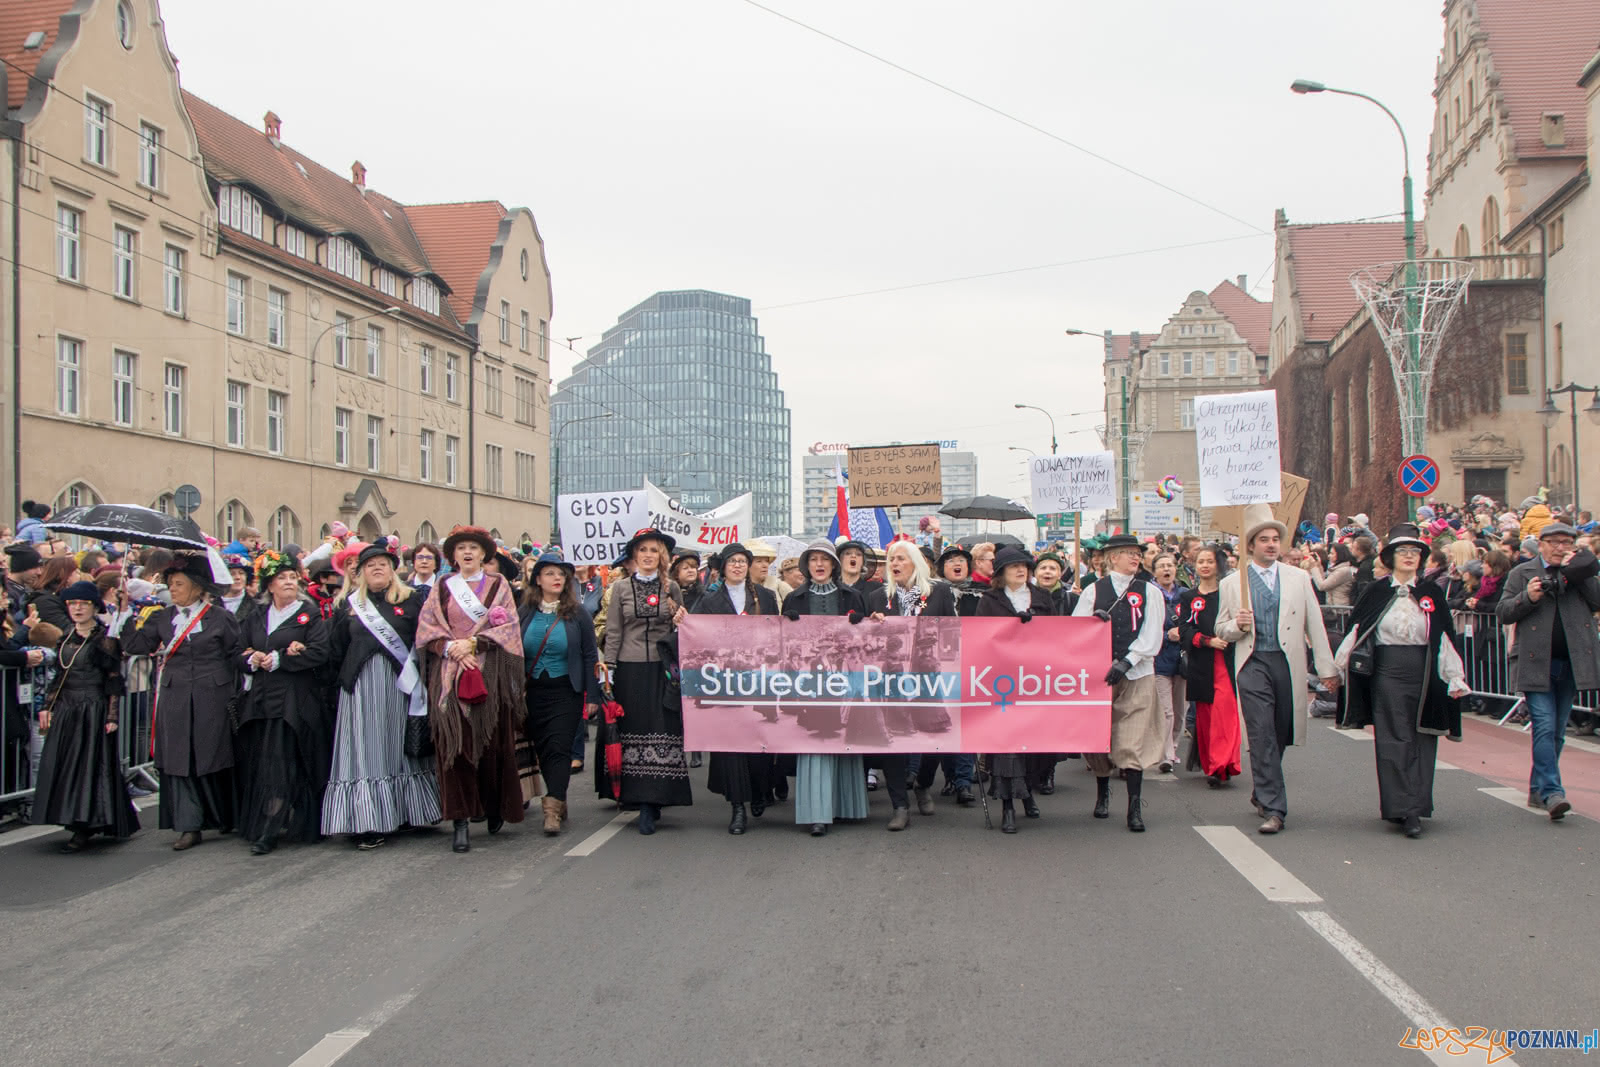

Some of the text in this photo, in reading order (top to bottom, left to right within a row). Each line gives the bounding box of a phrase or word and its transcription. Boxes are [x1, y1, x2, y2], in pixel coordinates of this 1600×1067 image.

[1261, 415, 1273, 432] te
[851, 451, 871, 464] NIE
[905, 461, 937, 475] SAMA!
[1071, 469, 1109, 484] WOLNYMI
[853, 481, 873, 498] NIE
[571, 496, 634, 517] GŁOSY
[681, 493, 711, 504] Bank
[584, 520, 626, 539] DLA
[648, 511, 739, 544] AŁEGO ŻYCIA
[572, 542, 628, 561] KOBIE
[700, 663, 1090, 711] Stulecie Praw Kobiet
